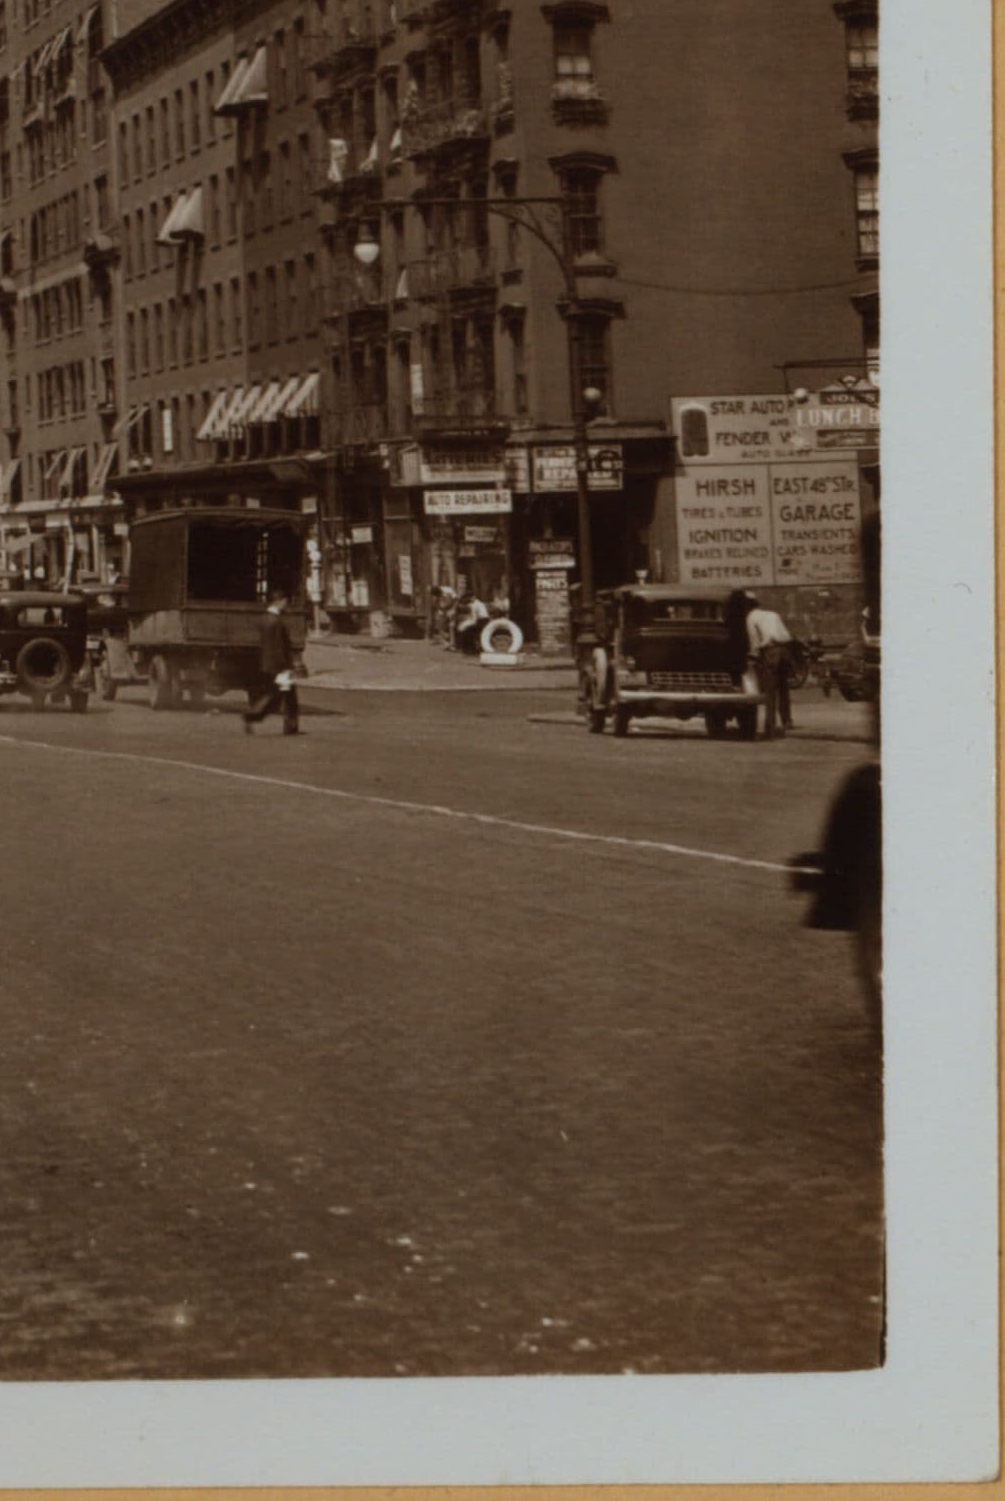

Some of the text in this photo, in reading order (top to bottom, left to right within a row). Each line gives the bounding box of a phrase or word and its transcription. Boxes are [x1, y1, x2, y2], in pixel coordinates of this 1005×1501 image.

[710, 401, 745, 415] STAR
[751, 401, 785, 414] AUTO
[797, 408, 862, 427] LUNCH
[715, 431, 771, 446] FENDER
[696, 478, 756, 497] HIRSH
[773, 477, 808, 495] EAST
[780, 503, 856, 522] GARAGE
[689, 528, 758, 544] IGNITION
[691, 565, 763, 579] BATTERIES
